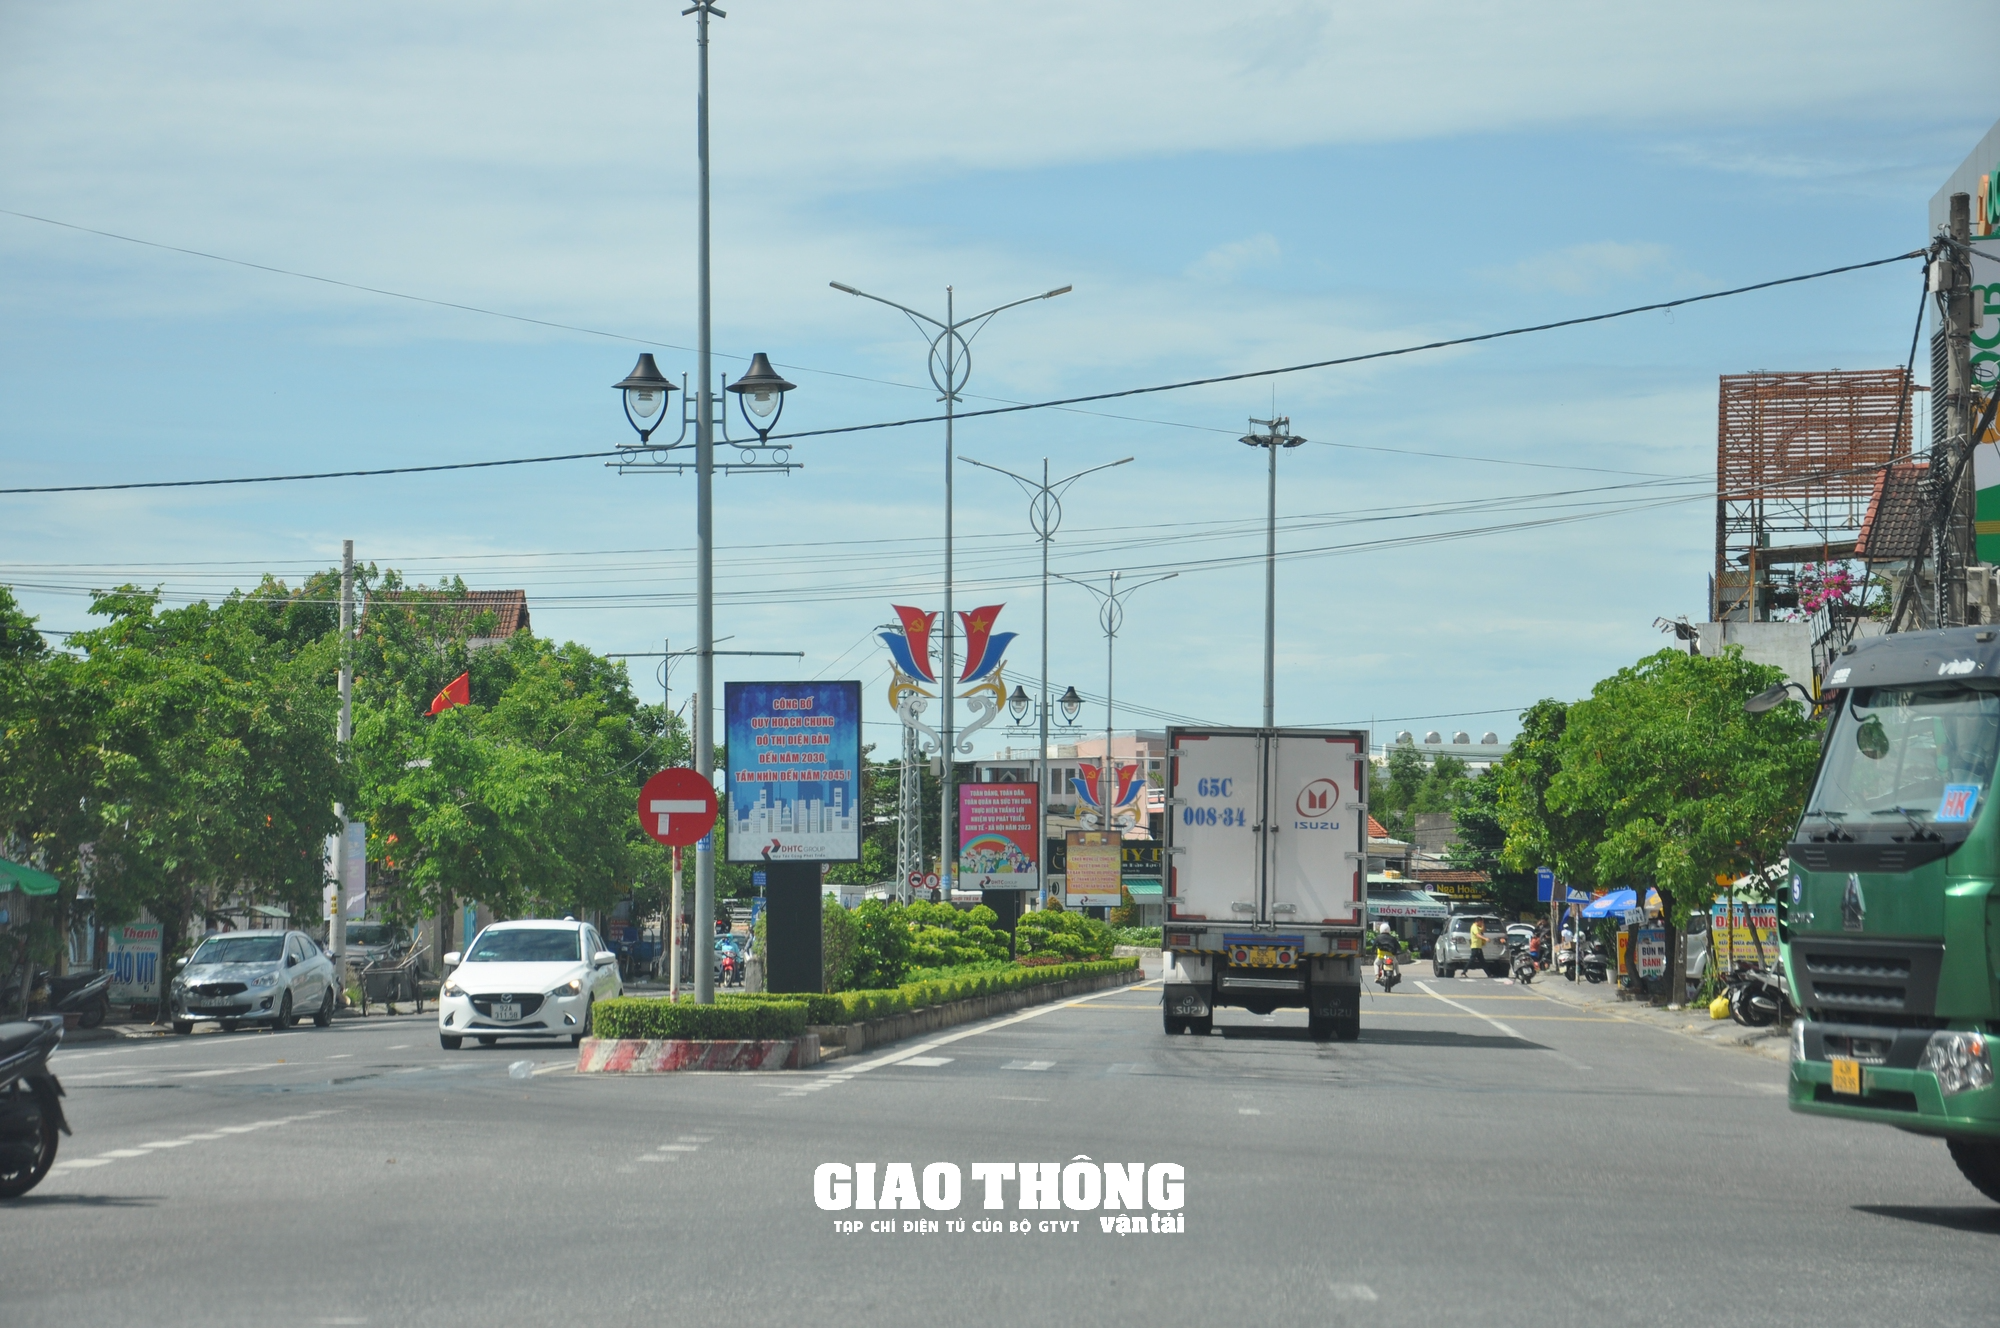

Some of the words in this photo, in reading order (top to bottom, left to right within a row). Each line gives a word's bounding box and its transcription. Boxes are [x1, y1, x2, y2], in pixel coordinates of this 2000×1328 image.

[773, 698, 798, 710] CÔNG
[800, 696, 814, 709] BỐ
[752, 718, 770, 728] QUY
[772, 718, 802, 730] HOẠCH
[804, 716, 834, 727] CHUNG
[771, 736, 785, 748] THỊ
[788, 734, 809, 748] ĐIỆN
[811, 733, 830, 744] BÀN
[759, 751, 777, 764] ĐẾN
[780, 752, 799, 763] NĂM
[801, 753, 827, 764] 2030,
[757, 770, 778, 782] NHÌN
[780, 768, 798, 781] ĐẾN
[800, 770, 820, 780] NĂM
[822, 770, 844, 780] 2045
[1198, 778, 1232, 798] 65C
[1940, 791, 1972, 817] HK
[1295, 821, 1339, 829] ISUZU
[1437, 884, 1454, 894] Nga
[123, 927, 158, 942] Thạnh
[108, 945, 133, 985] HÁO
[136, 952, 158, 992] VỊT
[1173, 1006, 1205, 1015] ISUZU
